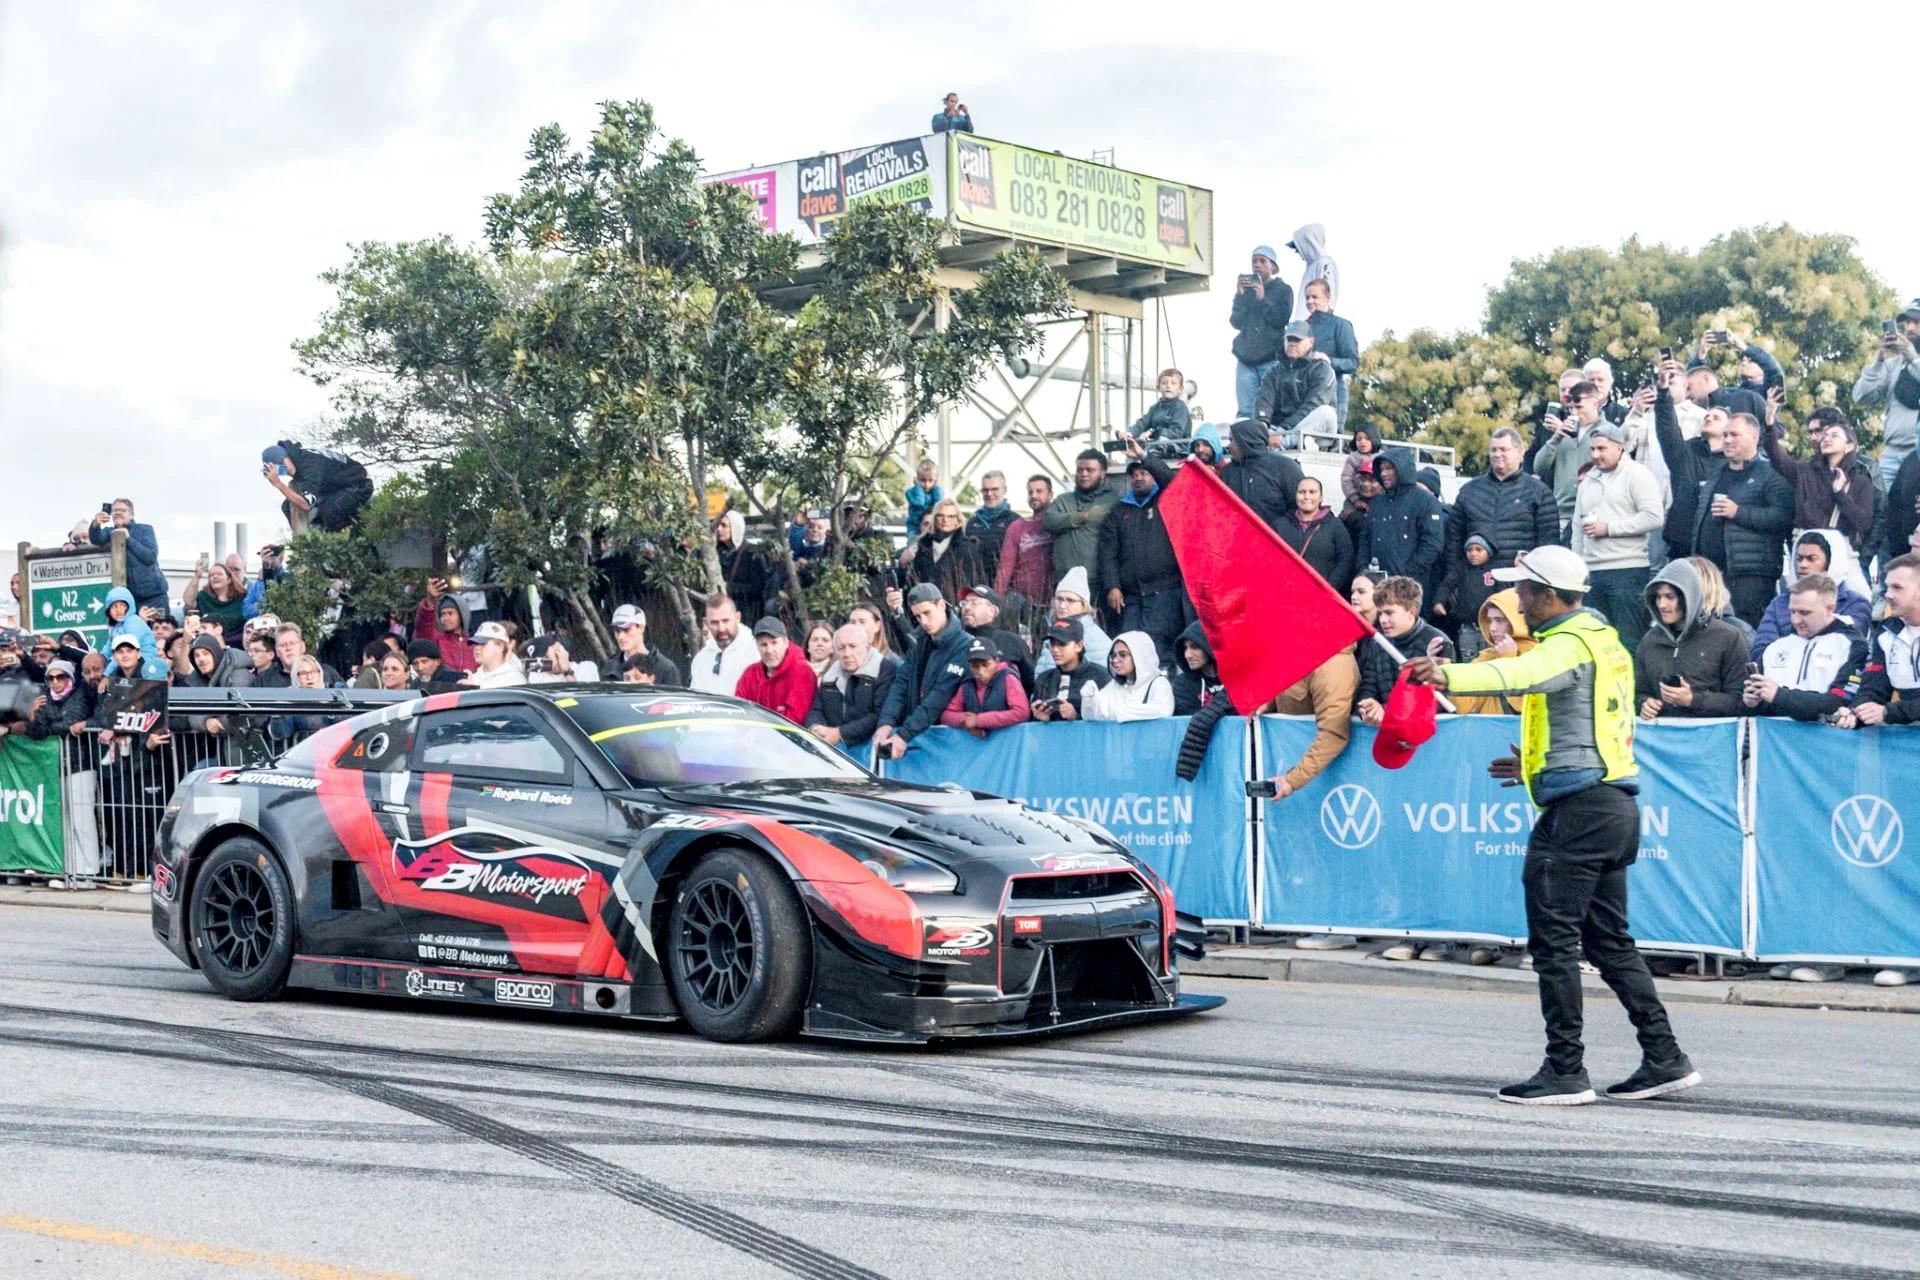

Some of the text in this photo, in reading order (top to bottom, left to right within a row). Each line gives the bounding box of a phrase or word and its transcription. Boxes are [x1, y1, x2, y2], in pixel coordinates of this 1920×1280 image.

[866, 146, 897, 168] LOCAL
[960, 146, 991, 179] call
[800, 156, 837, 193] call
[845, 150, 924, 196] REMOVALS
[1013, 151, 1141, 202] LOCAL REMOVALS
[899, 178, 929, 200] 0828
[801, 193, 838, 217] dave
[1010, 179, 1146, 239] 083 281 0828
[1159, 192, 1185, 220] call
[39, 561, 104, 578] Waterfront Drv.
[61, 590, 78, 607] N2
[54, 609, 87, 623] George
[113, 710, 161, 732] 300V
[236, 772, 322, 789] MOTORGROUP
[492, 787, 540, 802] Reghard
[1119, 832, 1192, 846] of the climb
[1475, 841, 1500, 856] For
[468, 863, 588, 905] Motorsport
[1018, 920, 1039, 929] TOW
[459, 949, 509, 966] Motorsport
[498, 982, 551, 1000] sparco
